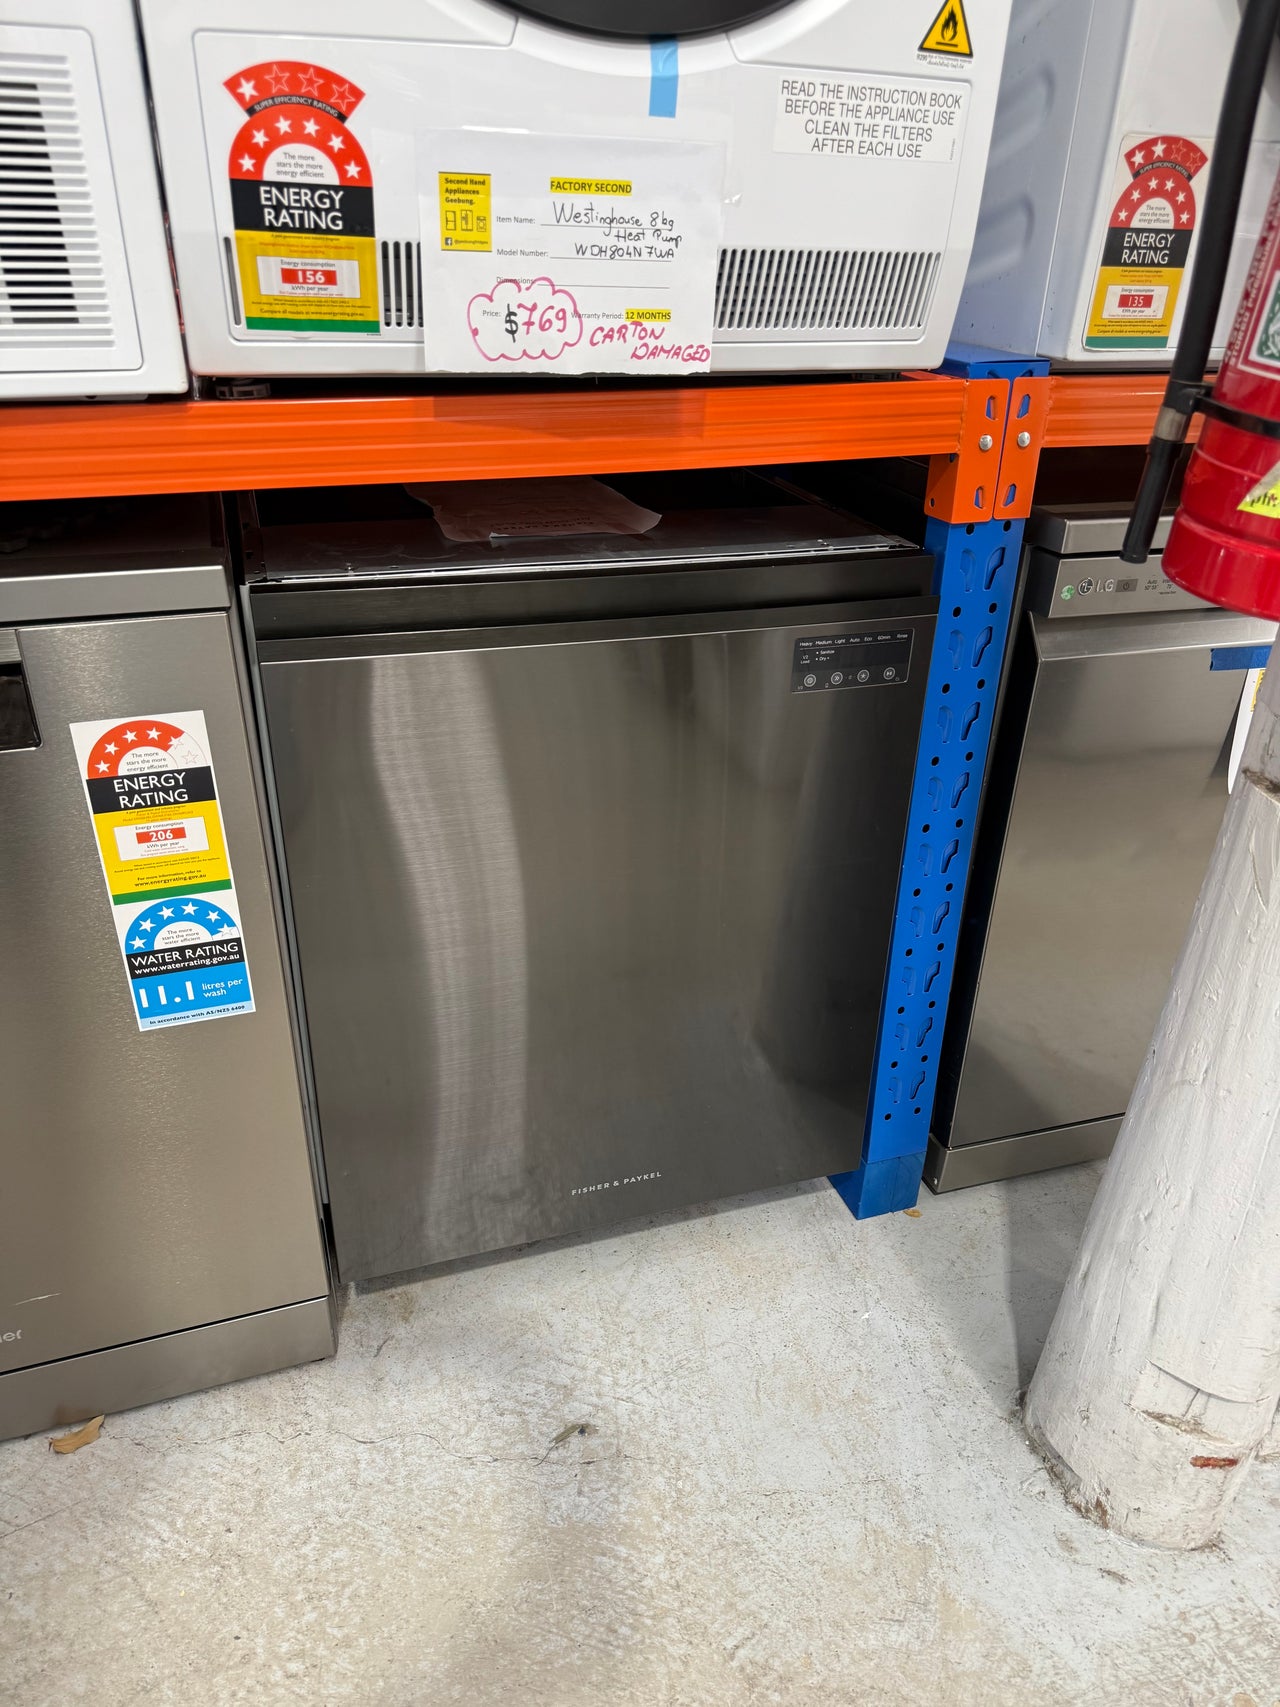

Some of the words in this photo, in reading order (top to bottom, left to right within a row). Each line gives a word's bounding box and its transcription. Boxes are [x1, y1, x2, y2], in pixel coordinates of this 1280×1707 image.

[781, 80, 815, 96] READ
[820, 83, 844, 99] THE
[847, 86, 927, 106] INSTRUCTION
[930, 93, 962, 109] BOOK
[253, 99, 274, 113] SUPER
[274, 96, 313, 106] EFFICIENCY
[313, 99, 339, 117] RATING
[785, 99, 835, 117] BEFORE
[839, 103, 862, 119] THE
[865, 105, 930, 124] APPLIANCE
[932, 111, 956, 126] USE
[805, 119, 850, 137] CLEAN
[854, 123, 880, 138] THE
[883, 125, 933, 142] FILTERS
[811, 138, 855, 154] AFTER
[858, 142, 893, 156] EACH
[897, 143, 923, 158] USE
[283, 152, 296, 161] The
[298, 154, 315, 162] more
[276, 161, 293, 169] stars
[276, 170, 298, 178] energy
[299, 170, 325, 178] efficient
[444, 177, 467, 186] Second
[469, 178, 486, 187] Hand
[550, 181, 593, 193] FACTORY
[595, 183, 632, 194] SECOND
[259, 185, 344, 210] ENERGY
[444, 187, 480, 196] Appliances
[445, 196, 476, 206] Geebung.
[264, 208, 344, 230] RATING
[496, 215, 508, 224] Item
[509, 216, 536, 224] Name:
[552, 201, 643, 237] Westinghouse
[615, 229, 646, 242] Heat
[652, 229, 682, 249] Pump
[1123, 232, 1176, 248] ENERGY
[496, 248, 518, 257] Model
[519, 249, 549, 258] Number:
[1120, 249, 1170, 265] RATING
[280, 259, 299, 268] Energy
[300, 261, 336, 269] consumption
[297, 270, 326, 284] 156
[1127, 295, 1144, 307] 135
[482, 309, 502, 317] Price:
[571, 311, 601, 320] Warranty
[602, 312, 624, 320] Period:
[625, 311, 635, 320] 12
[636, 311, 672, 320] MONTHS
[504, 302, 568, 343] $769
[589, 320, 665, 347] CARTON
[1229, 310, 1251, 367] STORED
[630, 343, 711, 363] DAMAGED
[1095, 579, 1115, 593] LG
[147, 763, 168, 771] efficient
[113, 772, 186, 793] ENERGY
[119, 789, 189, 809] RATING
[135, 824, 152, 832] Energy
[153, 821, 184, 829] consumption
[149, 830, 174, 842] 206
[134, 874, 207, 889] www.energyrating.gov.au
[131, 951, 182, 967] WATER
[185, 942, 239, 959] RATING
[134, 953, 240, 975] www.waterrating.gov.au
[201, 981, 226, 991] litres
[227, 978, 244, 989] per
[138, 980, 195, 1009] 11.1
[203, 988, 227, 999] wash
[157, 1013, 190, 1025] accordance
[191, 1011, 205, 1019] with
[571, 1182, 611, 1196] FISHER
[612, 1180, 620, 1188] &
[623, 1171, 663, 1185] PAYKEL
